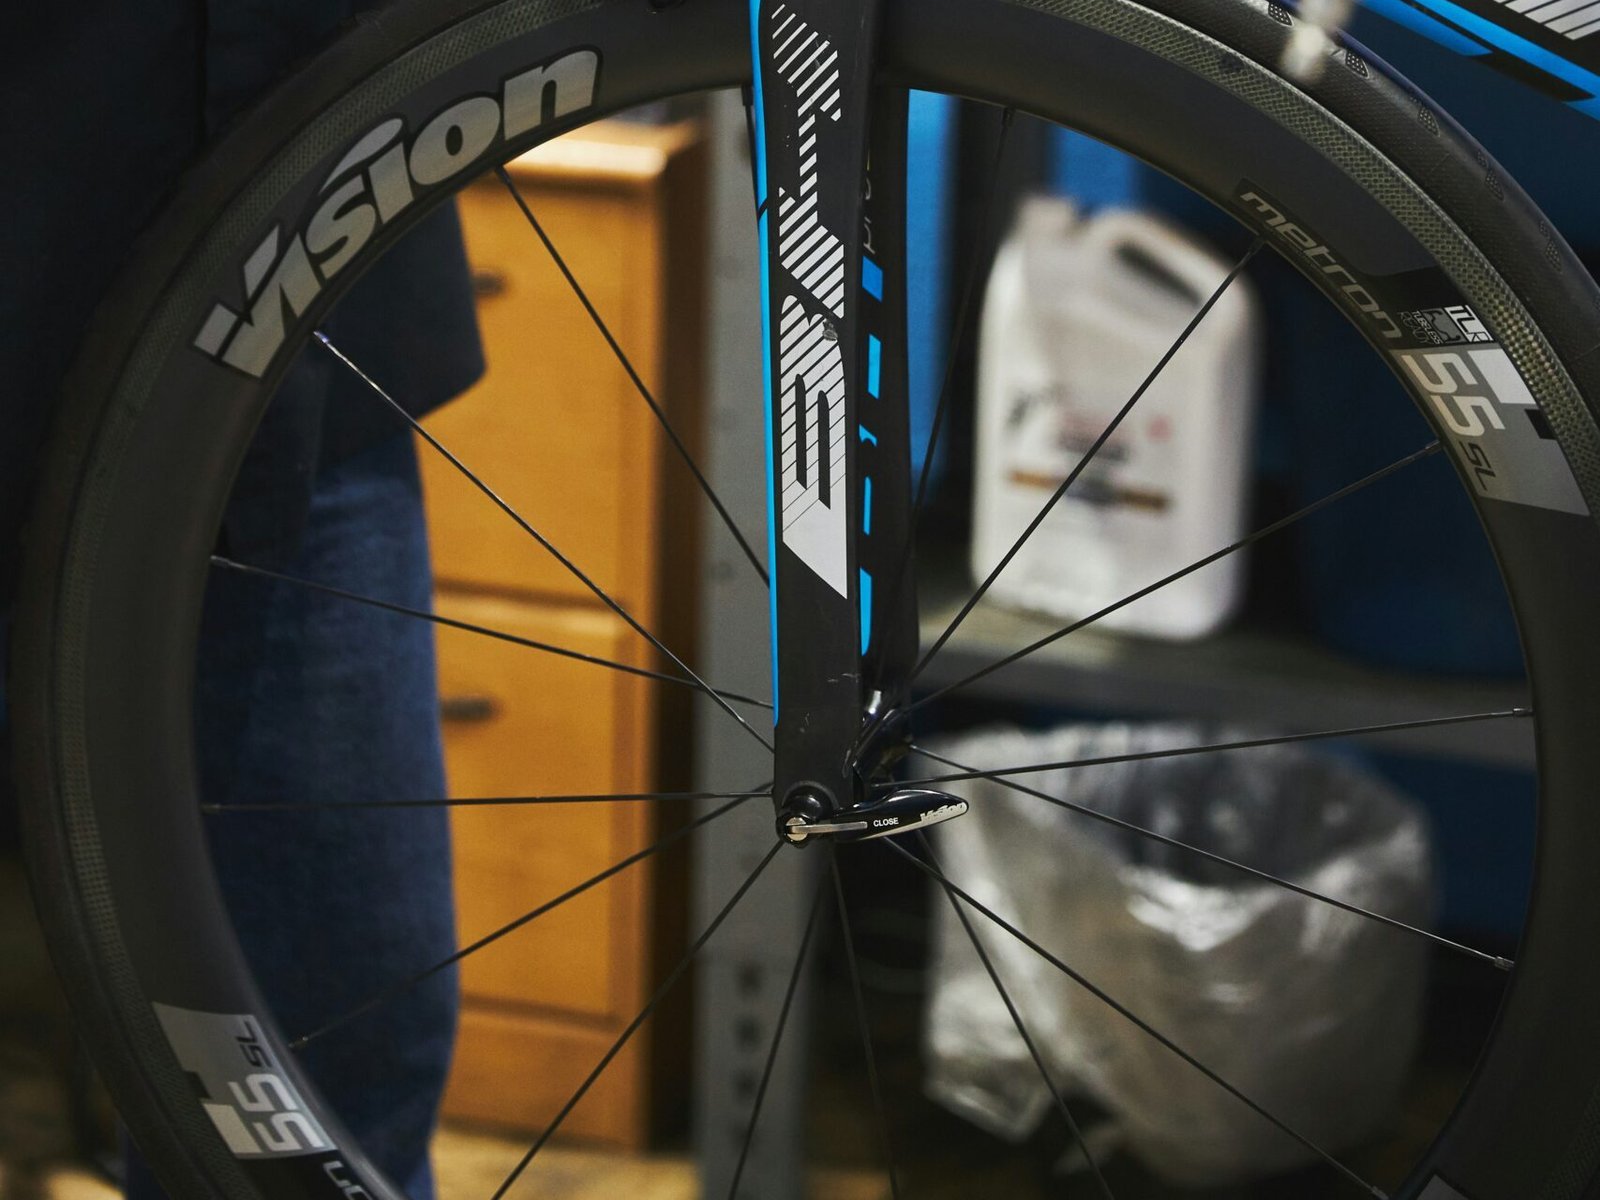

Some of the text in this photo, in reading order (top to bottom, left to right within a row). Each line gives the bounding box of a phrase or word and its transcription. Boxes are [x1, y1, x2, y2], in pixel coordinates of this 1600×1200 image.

[193, 49, 599, 379] Vision
[1240, 191, 1403, 339] metron
[1401, 352, 1506, 437] 55
[1459, 441, 1497, 492] SL
[872, 817, 900, 828] CLOSE
[235, 1020, 273, 1068] SL
[227, 1073, 326, 1151] 55
